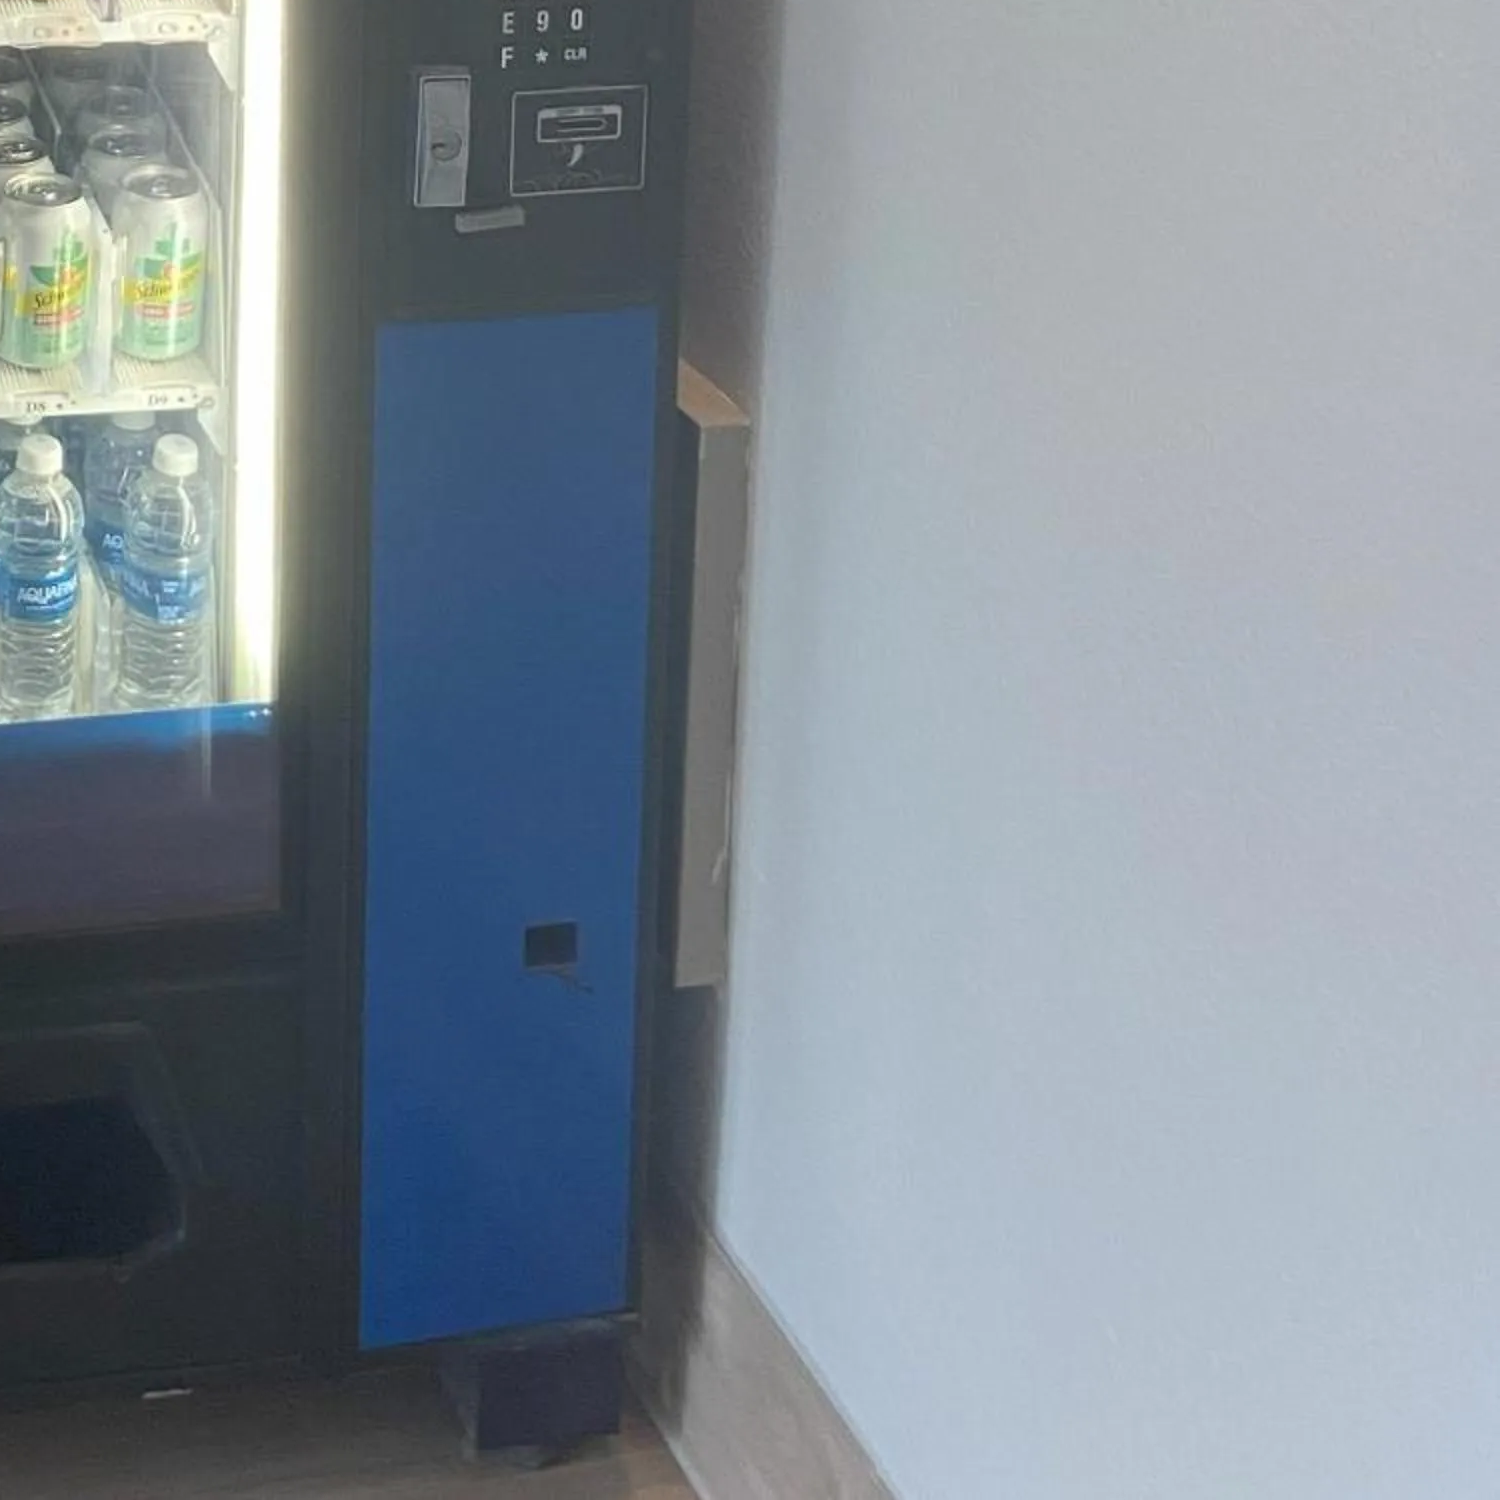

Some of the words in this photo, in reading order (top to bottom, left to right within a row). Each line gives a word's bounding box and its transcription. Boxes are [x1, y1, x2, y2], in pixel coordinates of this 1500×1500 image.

[502, 12, 515, 34] E
[537, 10, 549, 32] 9
[501, 47, 515, 69] F
